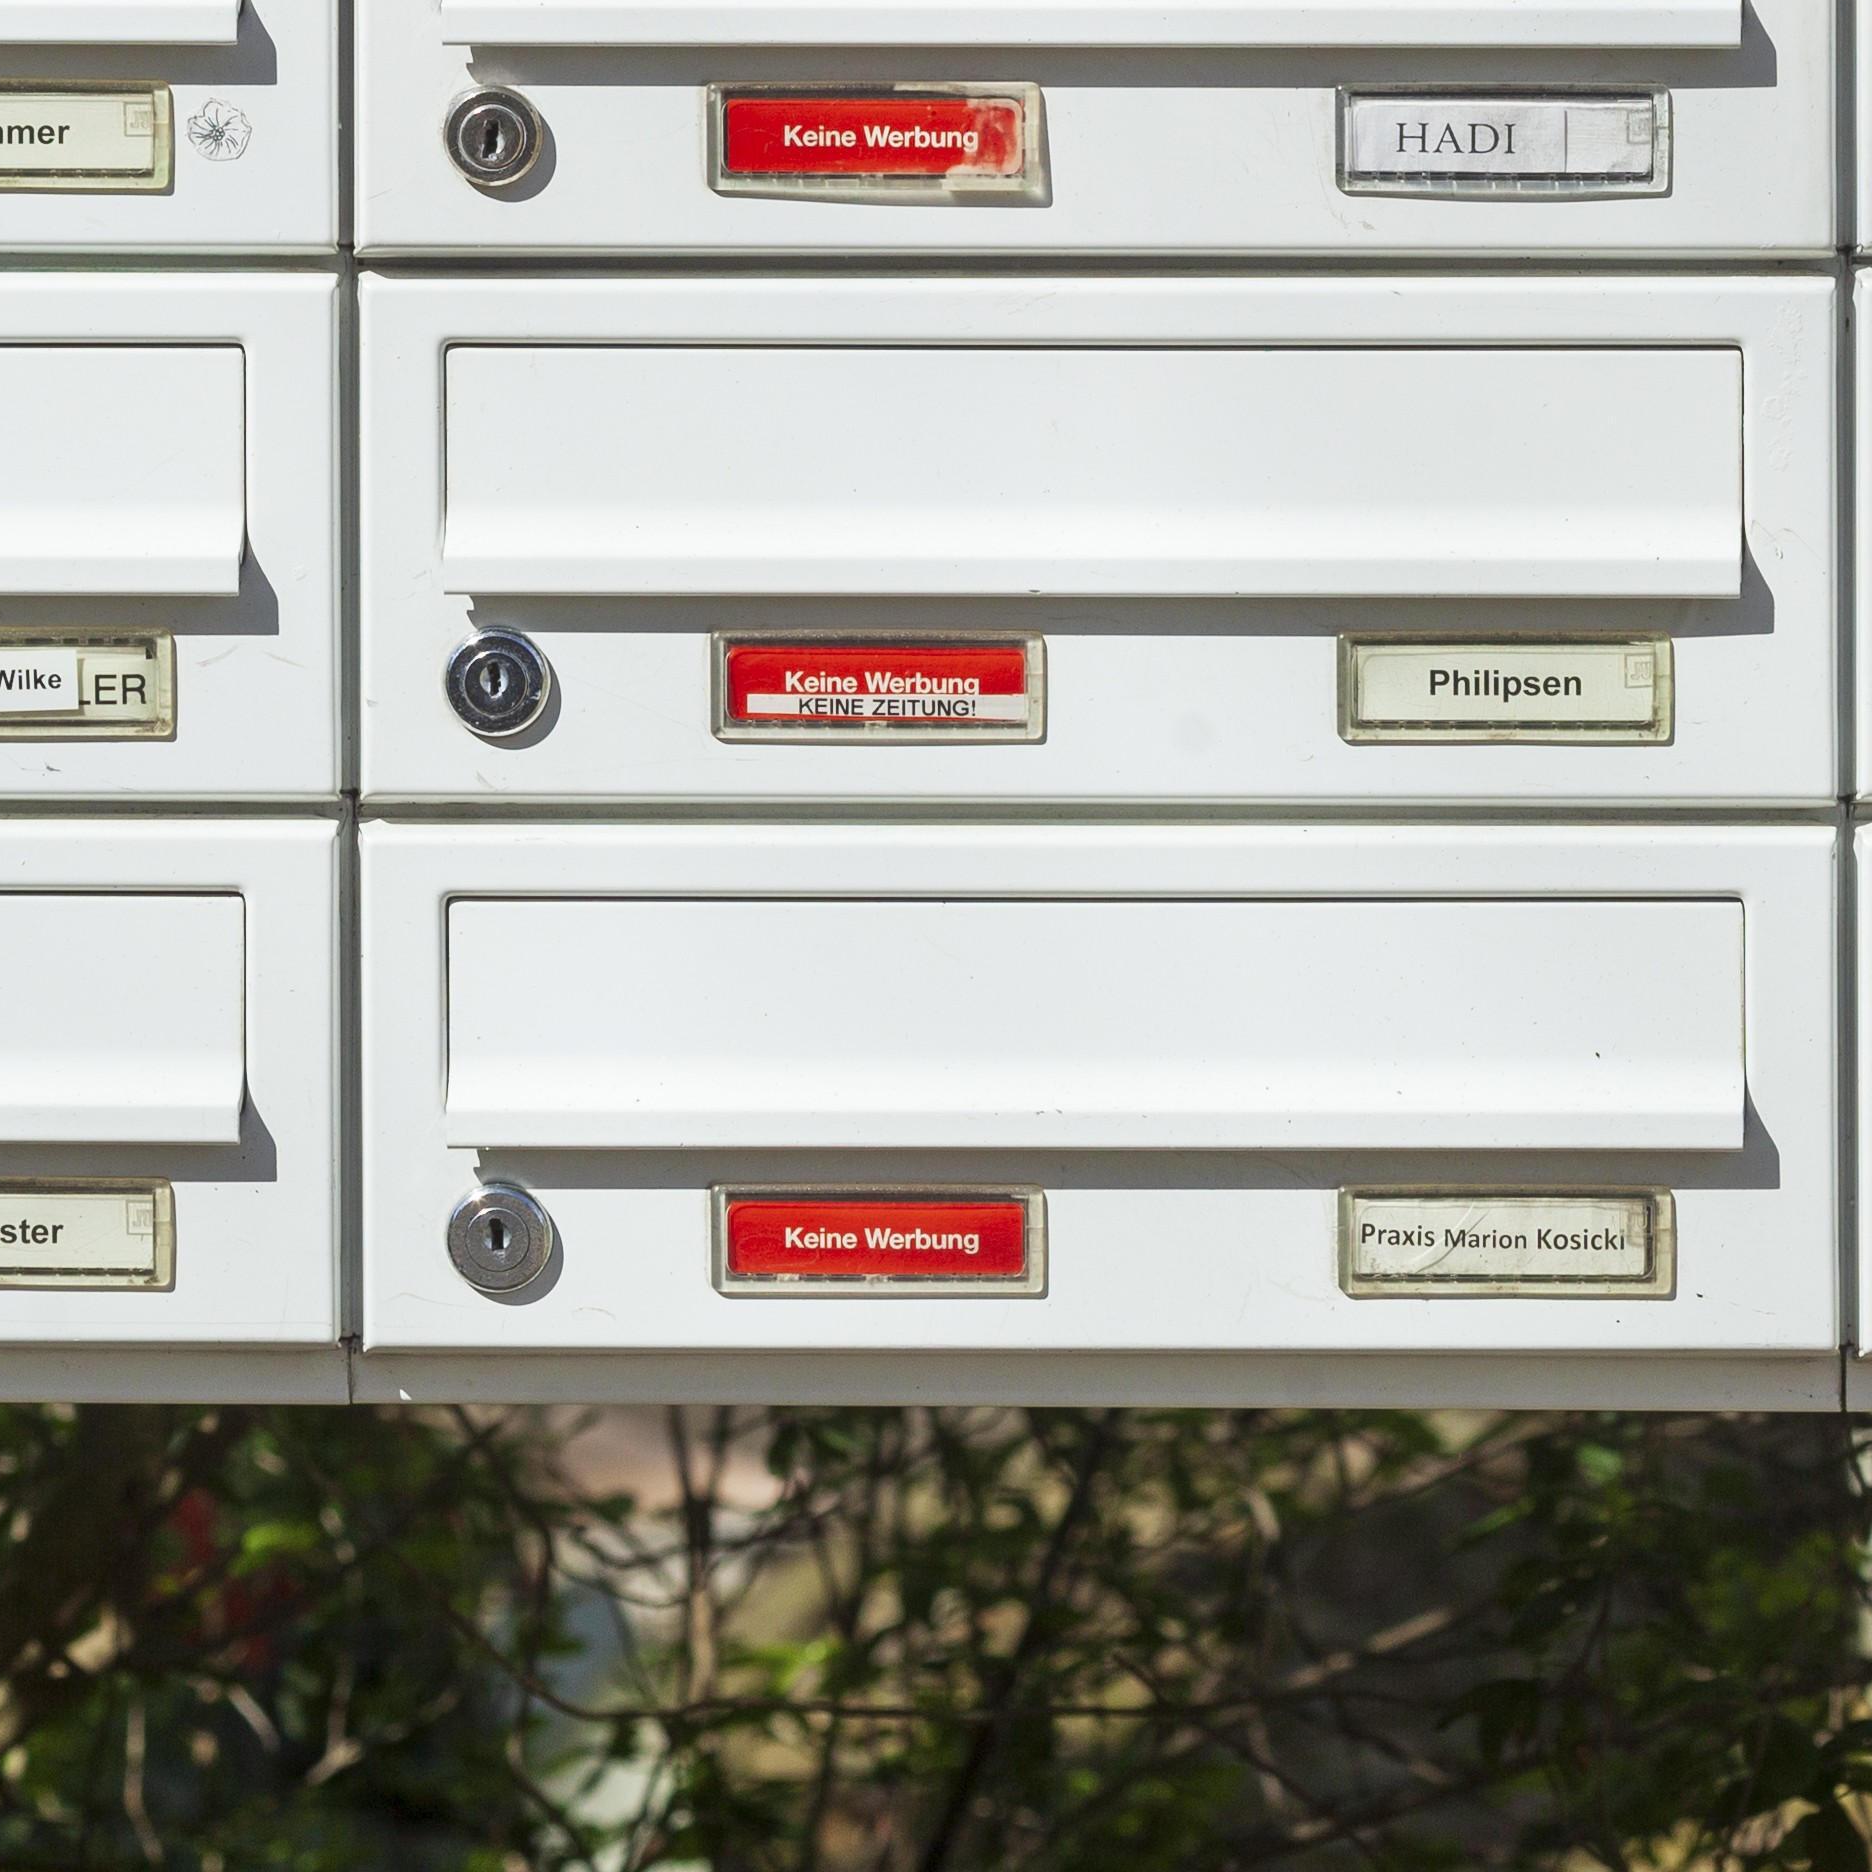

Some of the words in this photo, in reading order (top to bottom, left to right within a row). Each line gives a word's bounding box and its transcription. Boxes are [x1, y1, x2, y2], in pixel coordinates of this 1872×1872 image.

[784, 125, 856, 147] Keine
[864, 126, 979, 151] Werbung
[1396, 122, 1516, 154] HADI
[785, 671, 857, 693] Keine
[865, 672, 980, 694] Werbung
[1430, 669, 1582, 703] Philipsen
[799, 698, 864, 715] KEINE
[872, 699, 976, 717] ZEITUNG!
[785, 1227, 858, 1249] Keine
[865, 1228, 979, 1254] Werbung
[1361, 1223, 1435, 1247] Praxis
[1444, 1229, 1527, 1249] Marion
[1537, 1228, 1625, 1251] Kosicki
